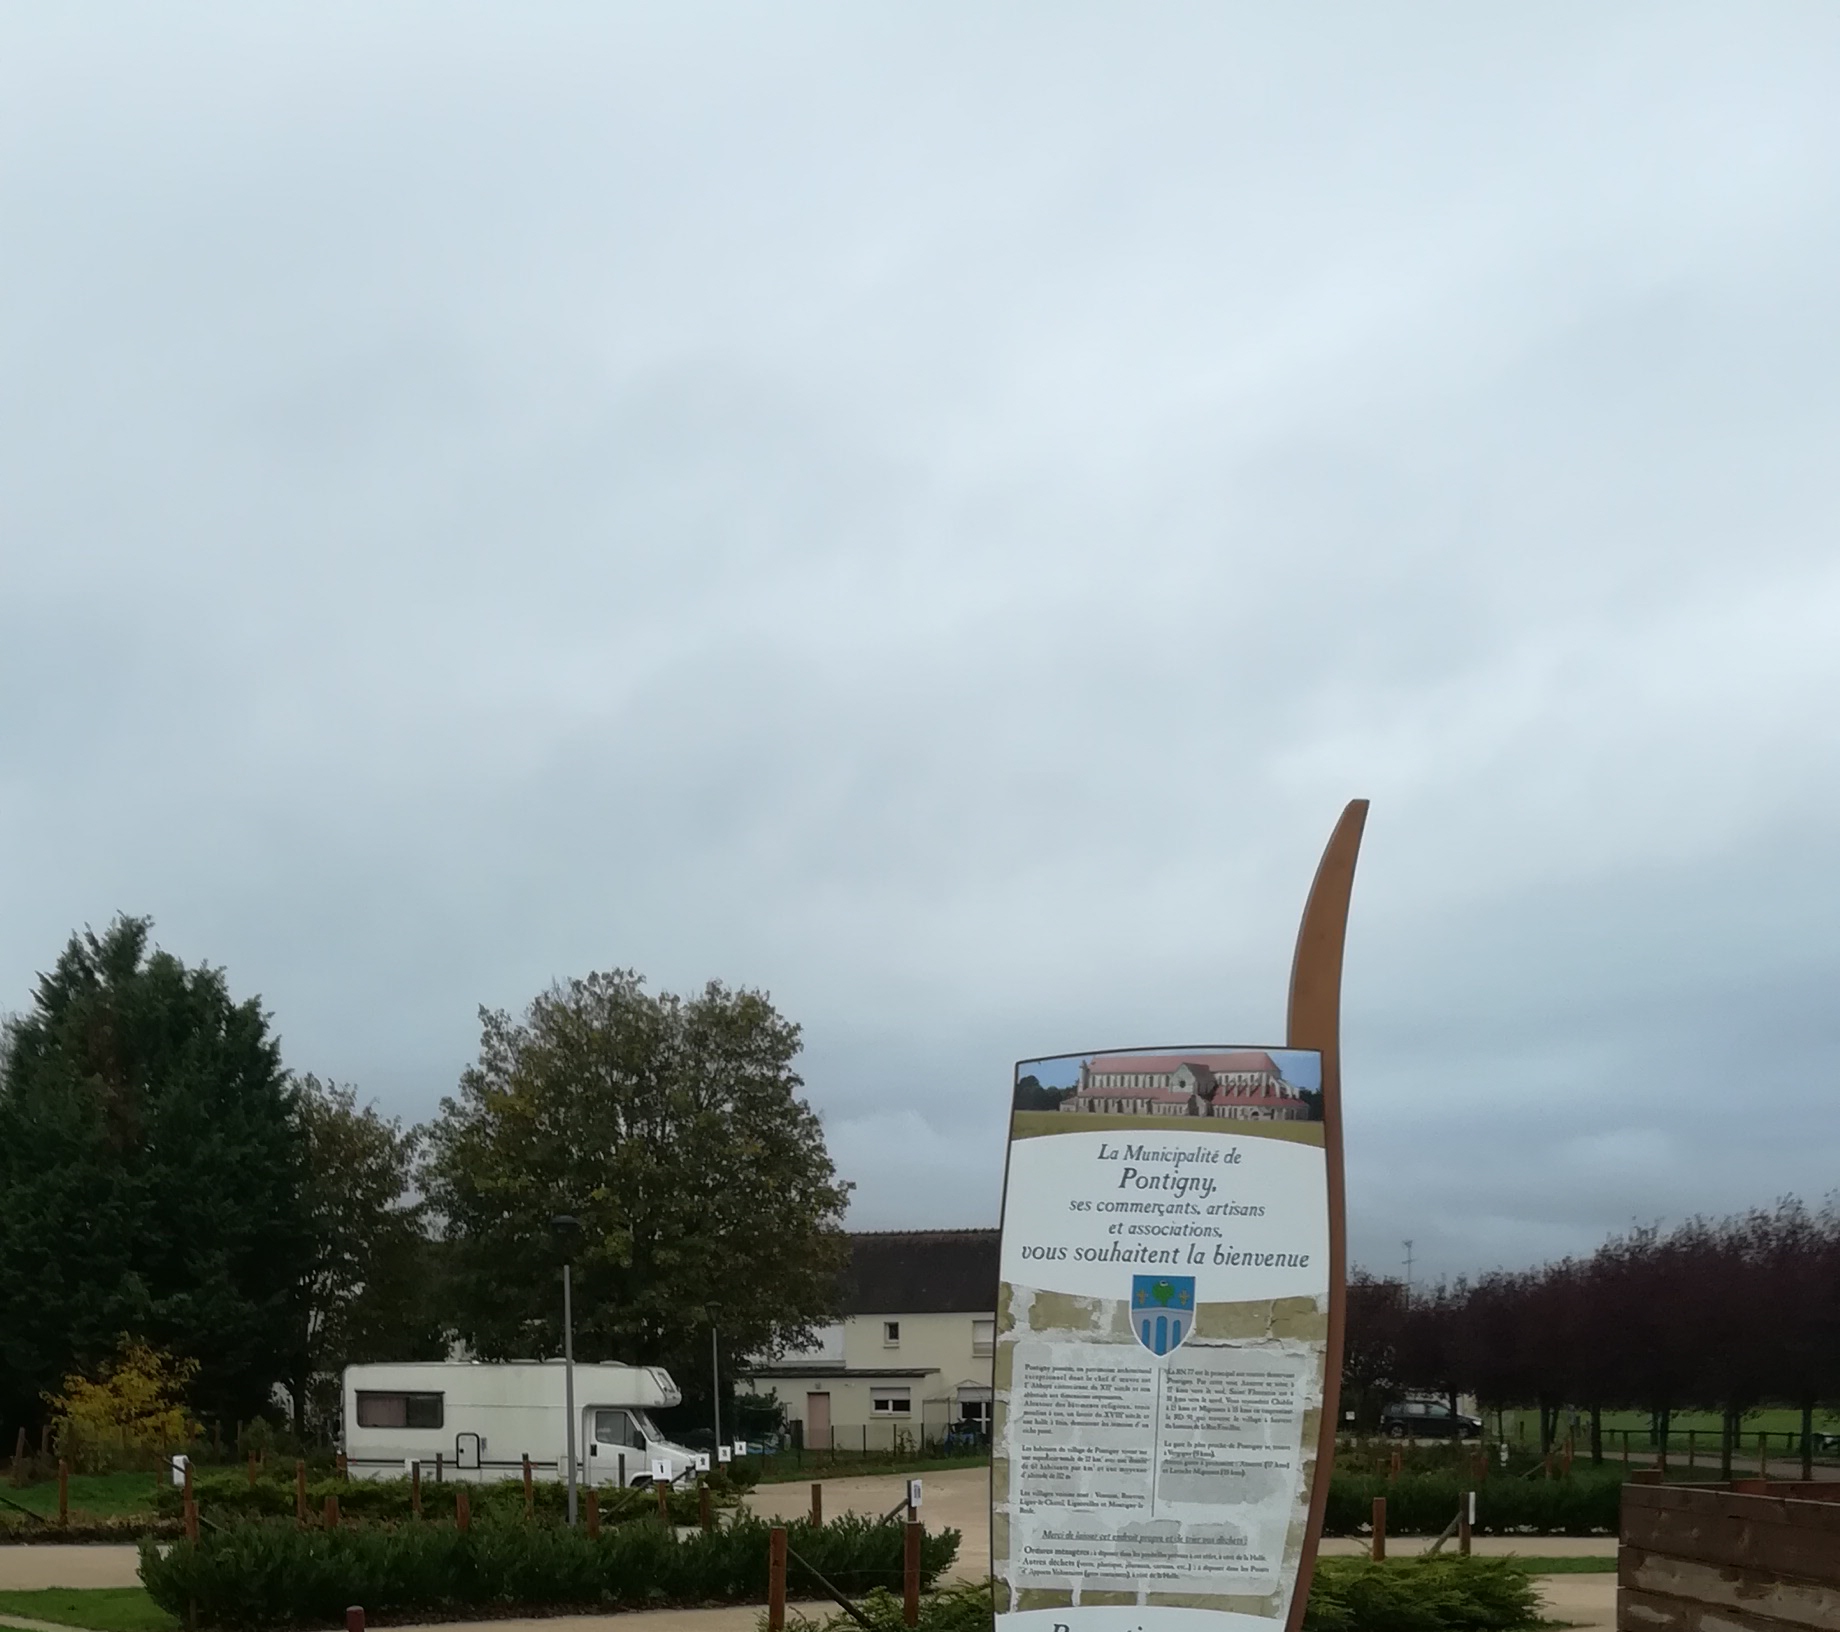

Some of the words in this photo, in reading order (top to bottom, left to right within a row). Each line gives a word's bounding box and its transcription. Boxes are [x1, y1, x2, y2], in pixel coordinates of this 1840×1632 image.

[1097, 1143, 1119, 1160] La
[1123, 1144, 1220, 1169] Municipalité
[1223, 1147, 1242, 1165] de
[1068, 1200, 1093, 1212] ses
[1206, 1200, 1266, 1217] artisans
[1108, 1222, 1124, 1235] et
[1021, 1245, 1068, 1261] vous
[1073, 1240, 1181, 1264] souhaitent
[1186, 1243, 1206, 1265] la
[1213, 1243, 1310, 1268] bienvenue
